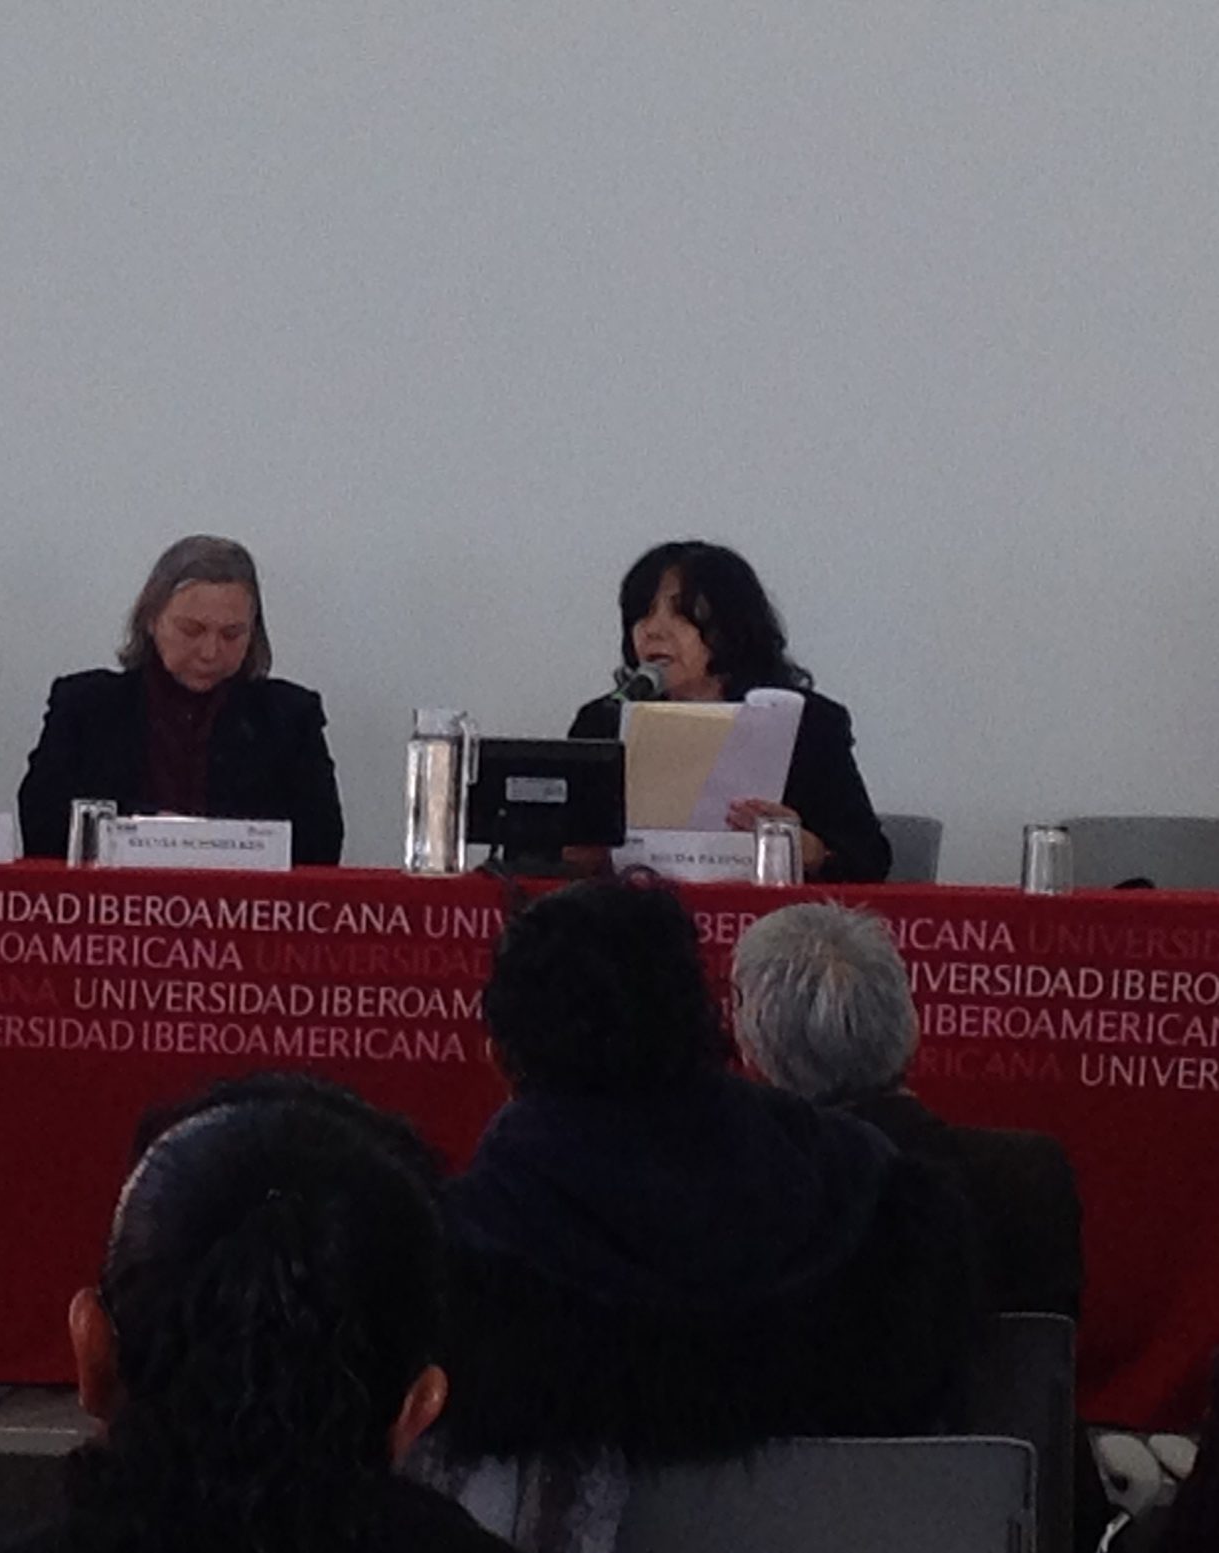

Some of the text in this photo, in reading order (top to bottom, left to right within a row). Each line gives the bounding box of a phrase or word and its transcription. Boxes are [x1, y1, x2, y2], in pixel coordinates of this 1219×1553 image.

[87, 893, 413, 937] IBEROAMERICANA
[73, 976, 315, 1016] UNIVERSIDAD
[142, 1021, 467, 1063] IBEROAMERICANA
